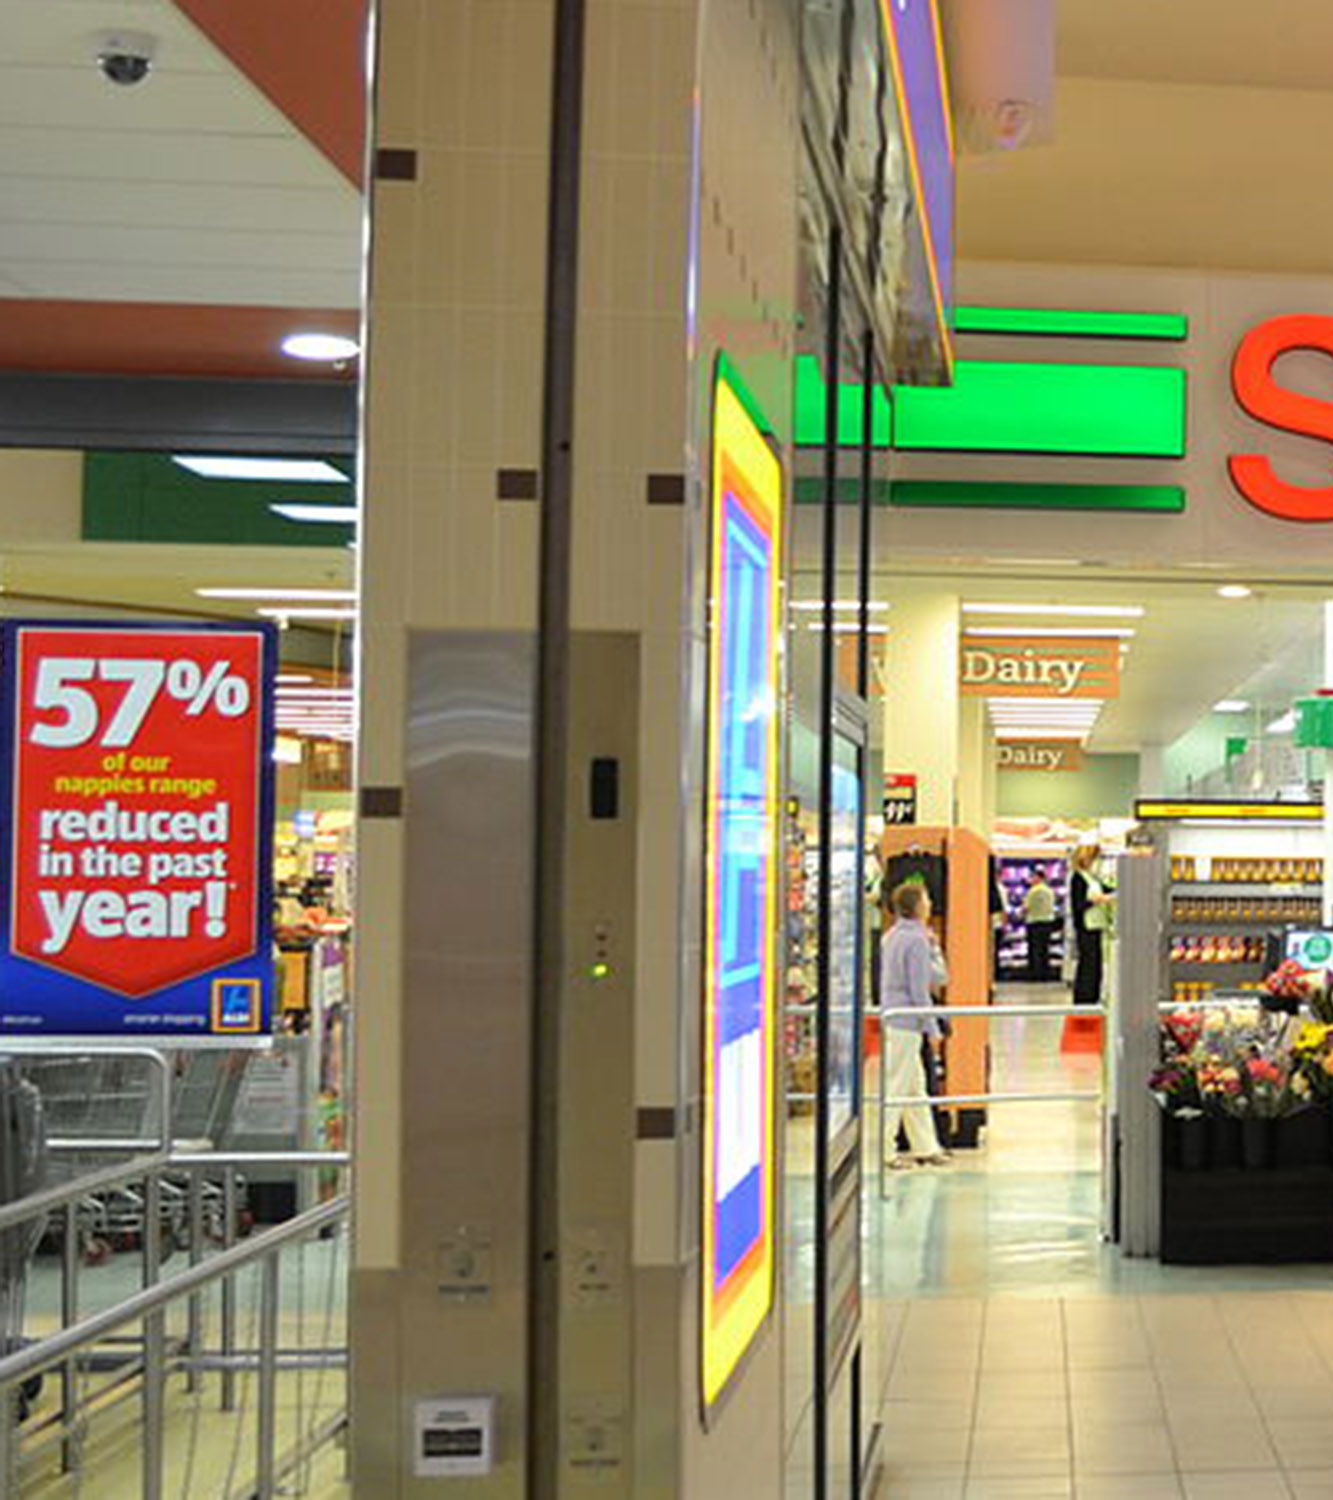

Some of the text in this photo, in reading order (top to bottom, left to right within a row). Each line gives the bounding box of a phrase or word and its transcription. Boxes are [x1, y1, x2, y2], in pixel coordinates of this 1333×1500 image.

[962, 648, 1084, 694] Dairy
[29, 657, 250, 748] 57%
[103, 752, 171, 772] of our
[998, 746, 1062, 769] Dairy
[55, 773, 217, 798] nappies range
[38, 801, 230, 842] reduced
[38, 844, 228, 885] in the past
